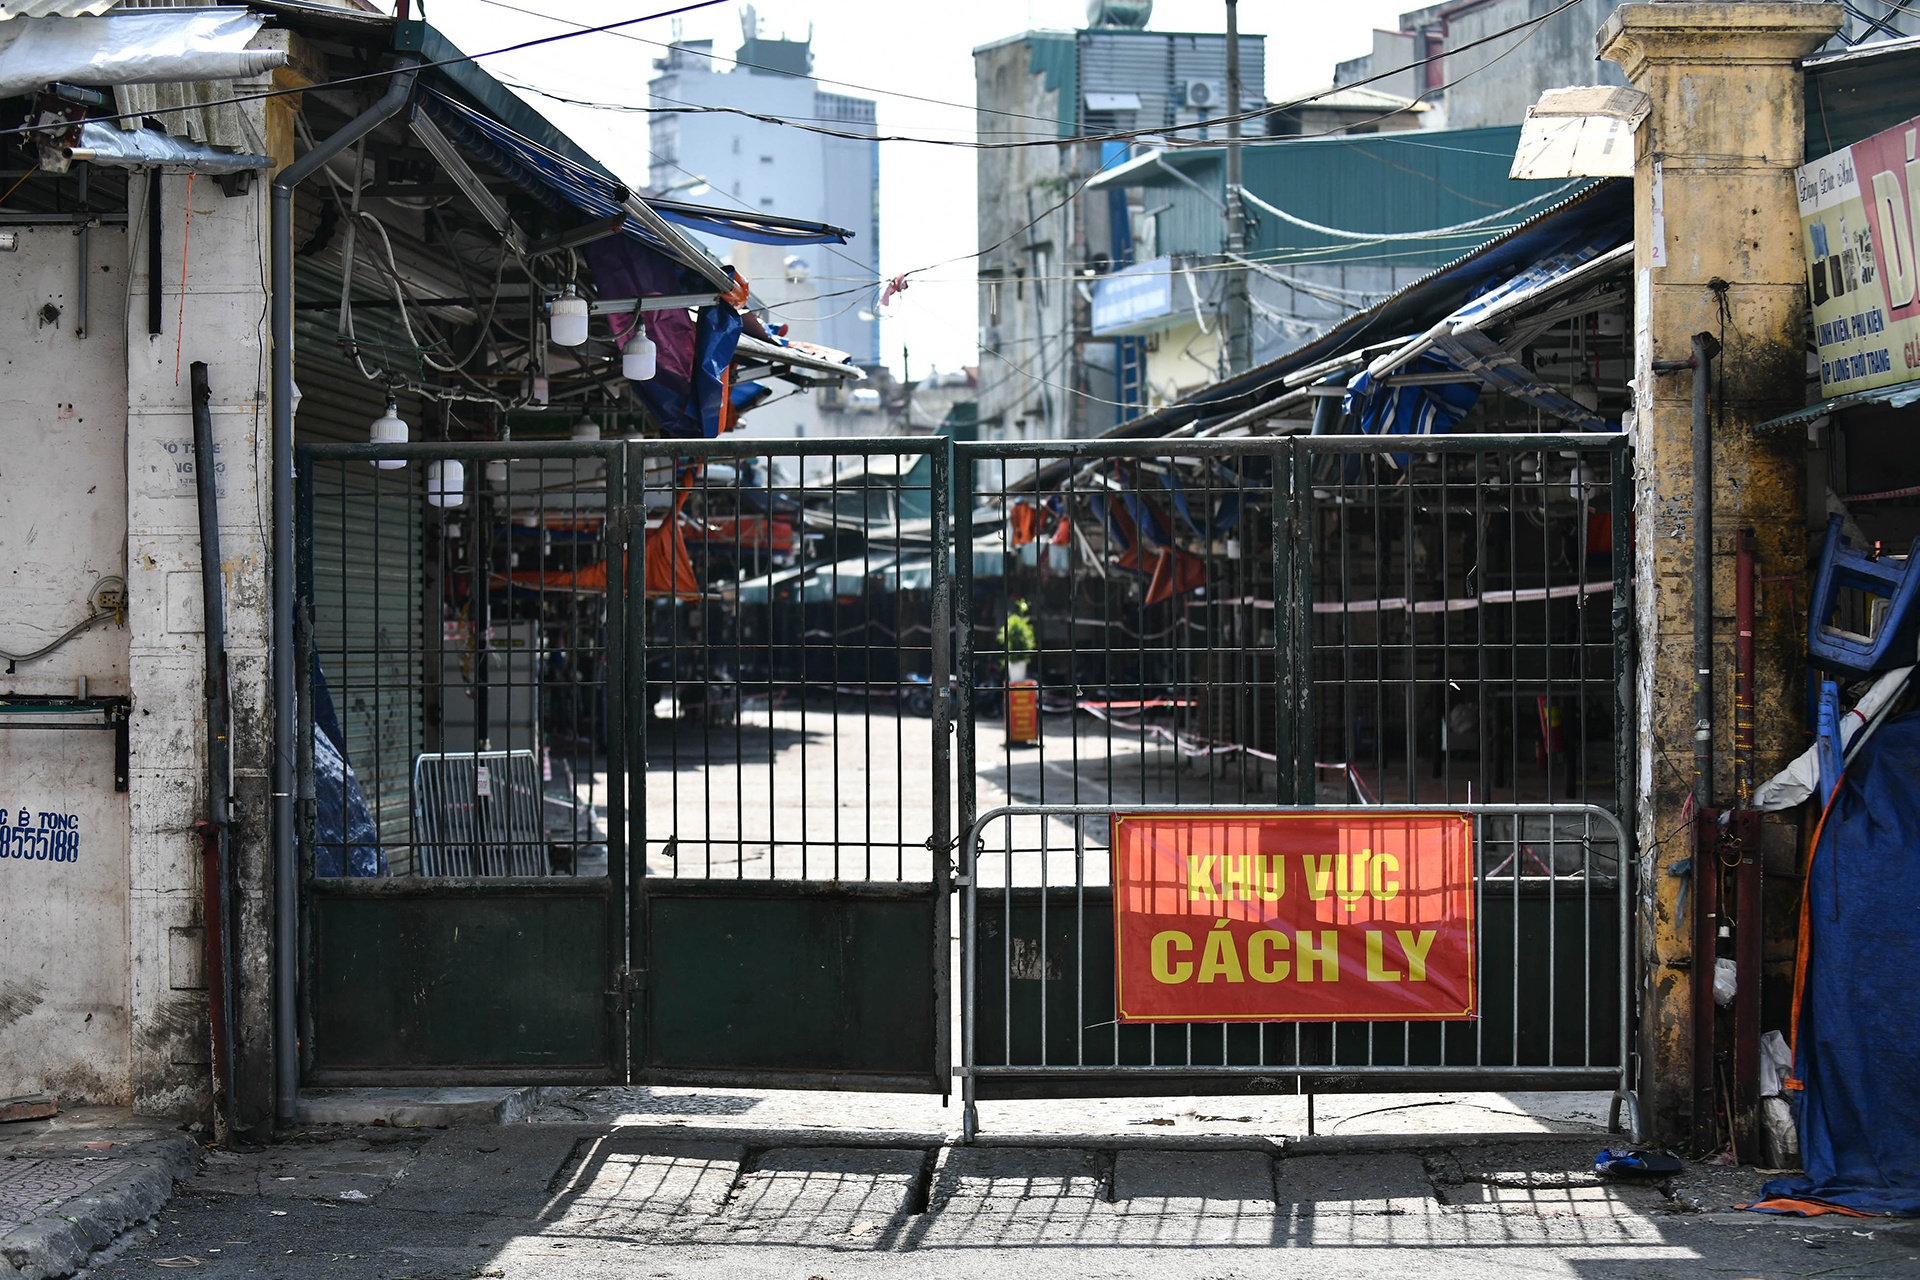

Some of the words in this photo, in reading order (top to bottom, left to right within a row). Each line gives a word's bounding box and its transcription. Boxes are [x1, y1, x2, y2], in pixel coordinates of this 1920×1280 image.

[1816, 322, 1833, 347] LINH
[1851, 313, 1867, 341] PHỤ
[1866, 305, 1884, 338] KIỆN
[1866, 348, 1891, 374] TRANG
[1187, 854, 1286, 902] KHU
[1302, 848, 1400, 912] VỰC
[1150, 918, 1340, 985] CÁCH
[1365, 929, 1438, 983] LY
